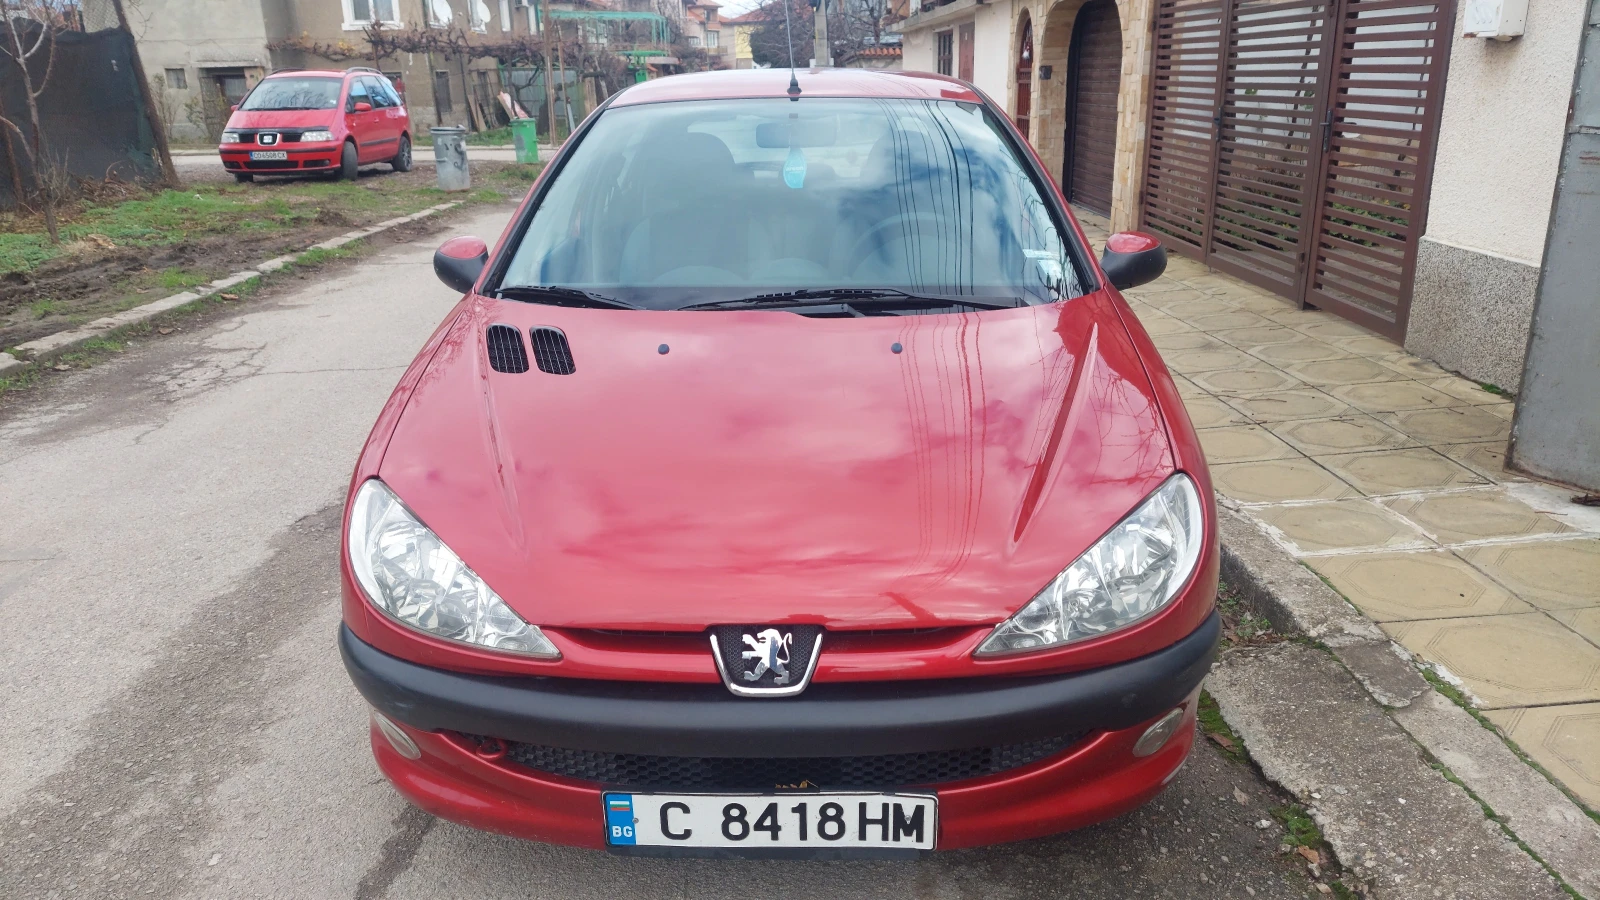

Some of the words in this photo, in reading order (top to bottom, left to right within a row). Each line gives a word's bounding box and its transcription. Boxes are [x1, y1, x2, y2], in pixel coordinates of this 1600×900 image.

[612, 826, 632, 837] BG
[660, 802, 692, 840] C
[721, 802, 846, 841] 8418
[858, 802, 925, 843] HM
